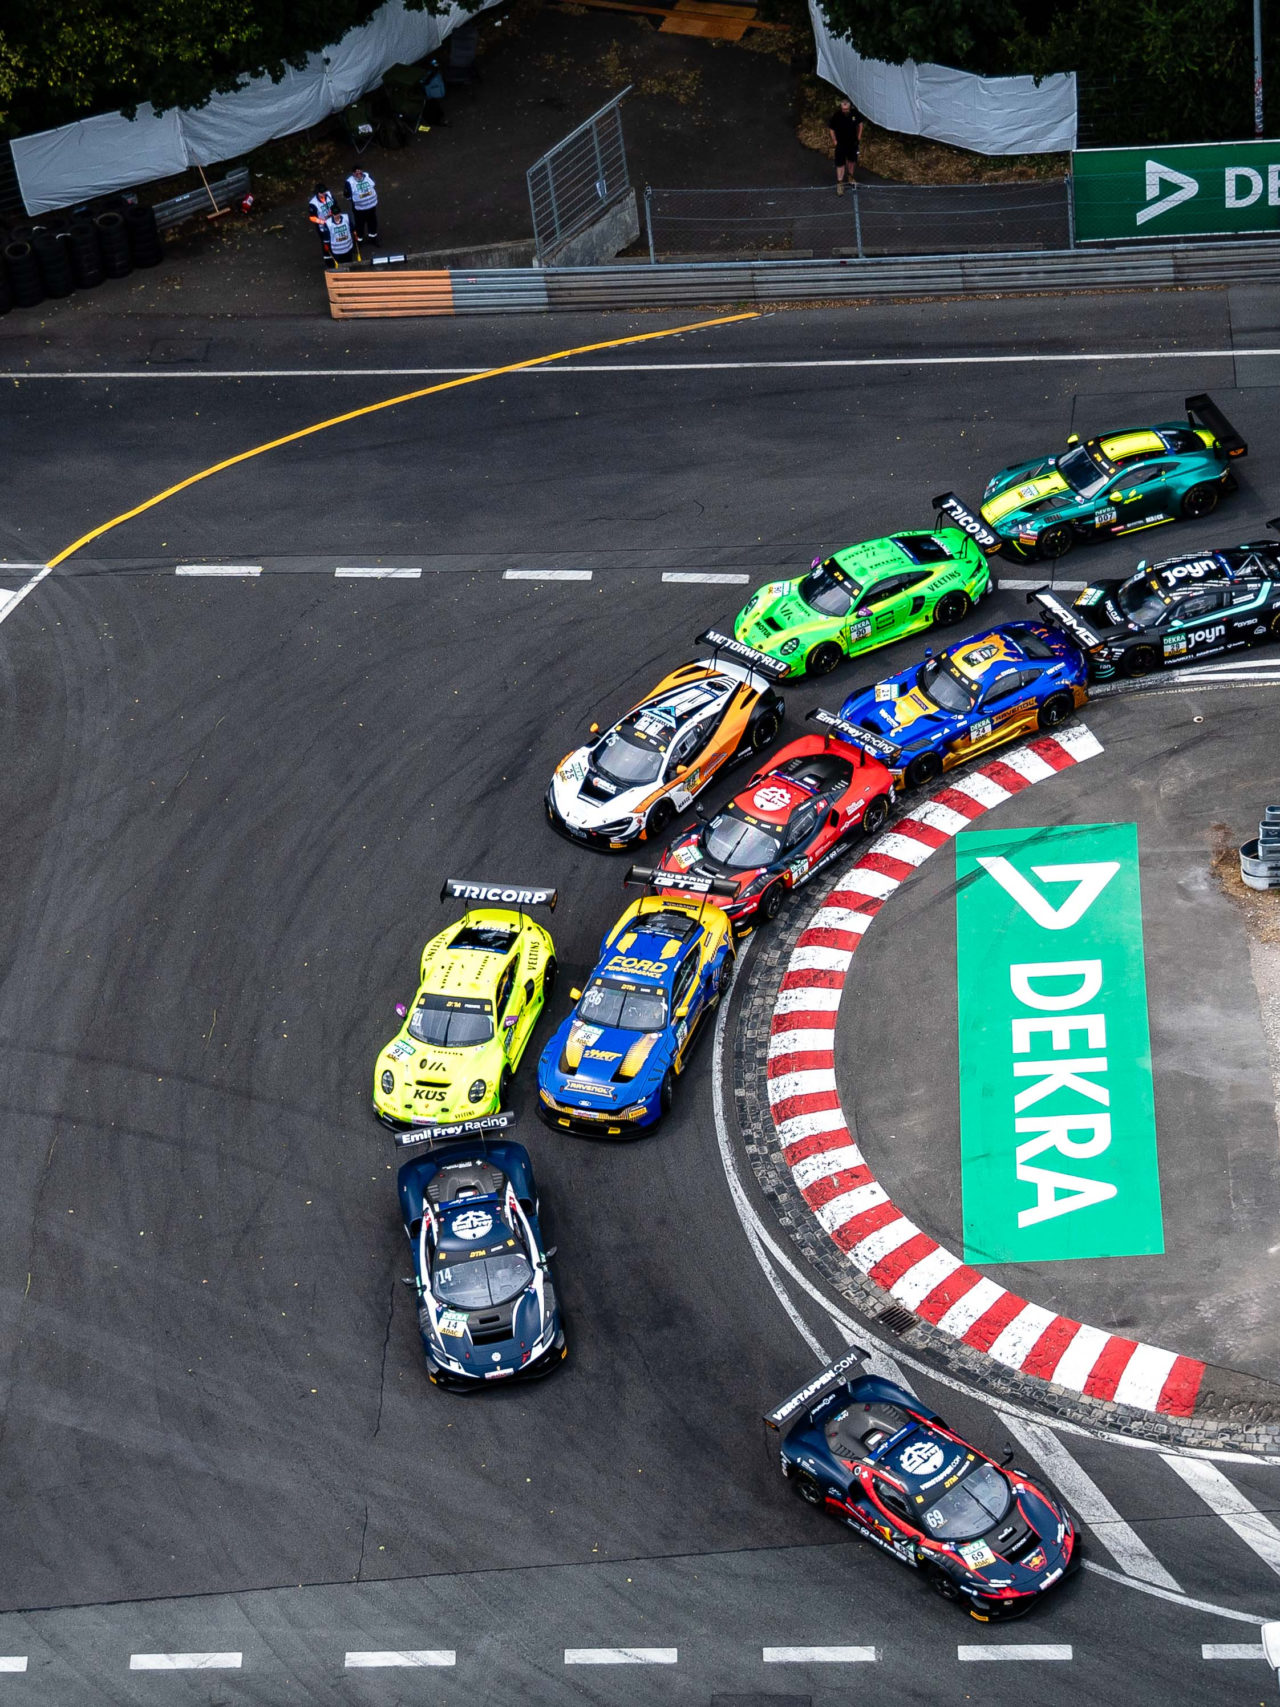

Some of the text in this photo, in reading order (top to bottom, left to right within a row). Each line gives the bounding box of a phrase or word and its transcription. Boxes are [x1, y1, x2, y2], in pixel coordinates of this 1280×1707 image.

[942, 499, 995, 546] TRICORP
[1098, 513, 1113, 523] 007
[927, 570, 961, 592] VELTINS
[755, 621, 772, 638] MOTUL
[850, 620, 870, 632] DEKRA
[1055, 605, 1099, 647] AMG
[856, 629, 867, 637] 90
[1164, 634, 1185, 645] DEKRA
[705, 630, 787, 672] MOTORWORLD
[996, 700, 1034, 719] RAVENOL
[970, 719, 990, 731] DEKRA
[816, 712, 895, 754] Emil Frey Racing
[564, 769, 575, 780] 25
[681, 851, 692, 862] 10
[654, 877, 711, 892] GT3
[658, 872, 713, 884] MUSTANG
[452, 884, 547, 905] TRICORP
[528, 941, 540, 971] VELTINS
[604, 965, 661, 978] PERFORMANCE
[608, 956, 669, 974] FORD
[412, 1013, 424, 1027] 91
[393, 1048, 404, 1057] 91
[414, 1090, 447, 1101] KÜS
[571, 1083, 610, 1095] RAVENOL
[1009, 959, 1118, 1229] DEKRA
[402, 1116, 508, 1145] Emil Frey Racing
[469, 1250, 486, 1258] DTM
[438, 1268, 452, 1284] 14
[443, 1313, 468, 1322] DEKRA
[446, 1321, 458, 1330] 14
[772, 1353, 858, 1421] VERSTAPPEN.COM
[944, 1475, 959, 1488] DTM
[926, 1509, 944, 1528] 69
[971, 1551, 984, 1561] 69
[974, 1559, 991, 1568] ADAC
